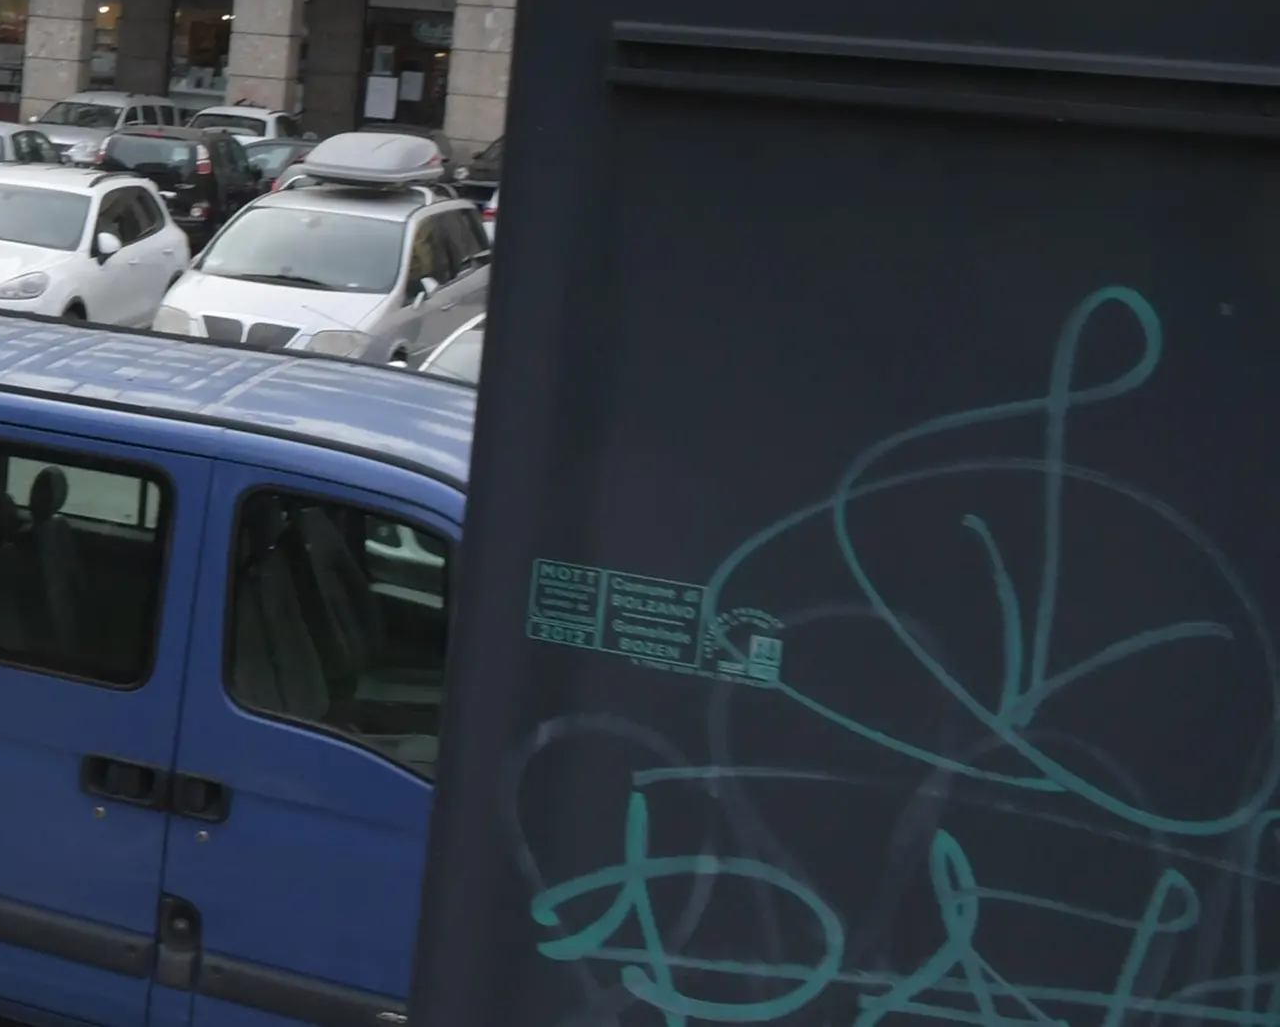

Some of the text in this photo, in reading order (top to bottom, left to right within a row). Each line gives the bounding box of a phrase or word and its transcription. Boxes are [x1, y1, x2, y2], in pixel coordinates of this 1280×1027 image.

[612, 593, 696, 620] BOLZANO
[540, 623, 586, 645] 2012
[620, 637, 681, 659] BOZEN
